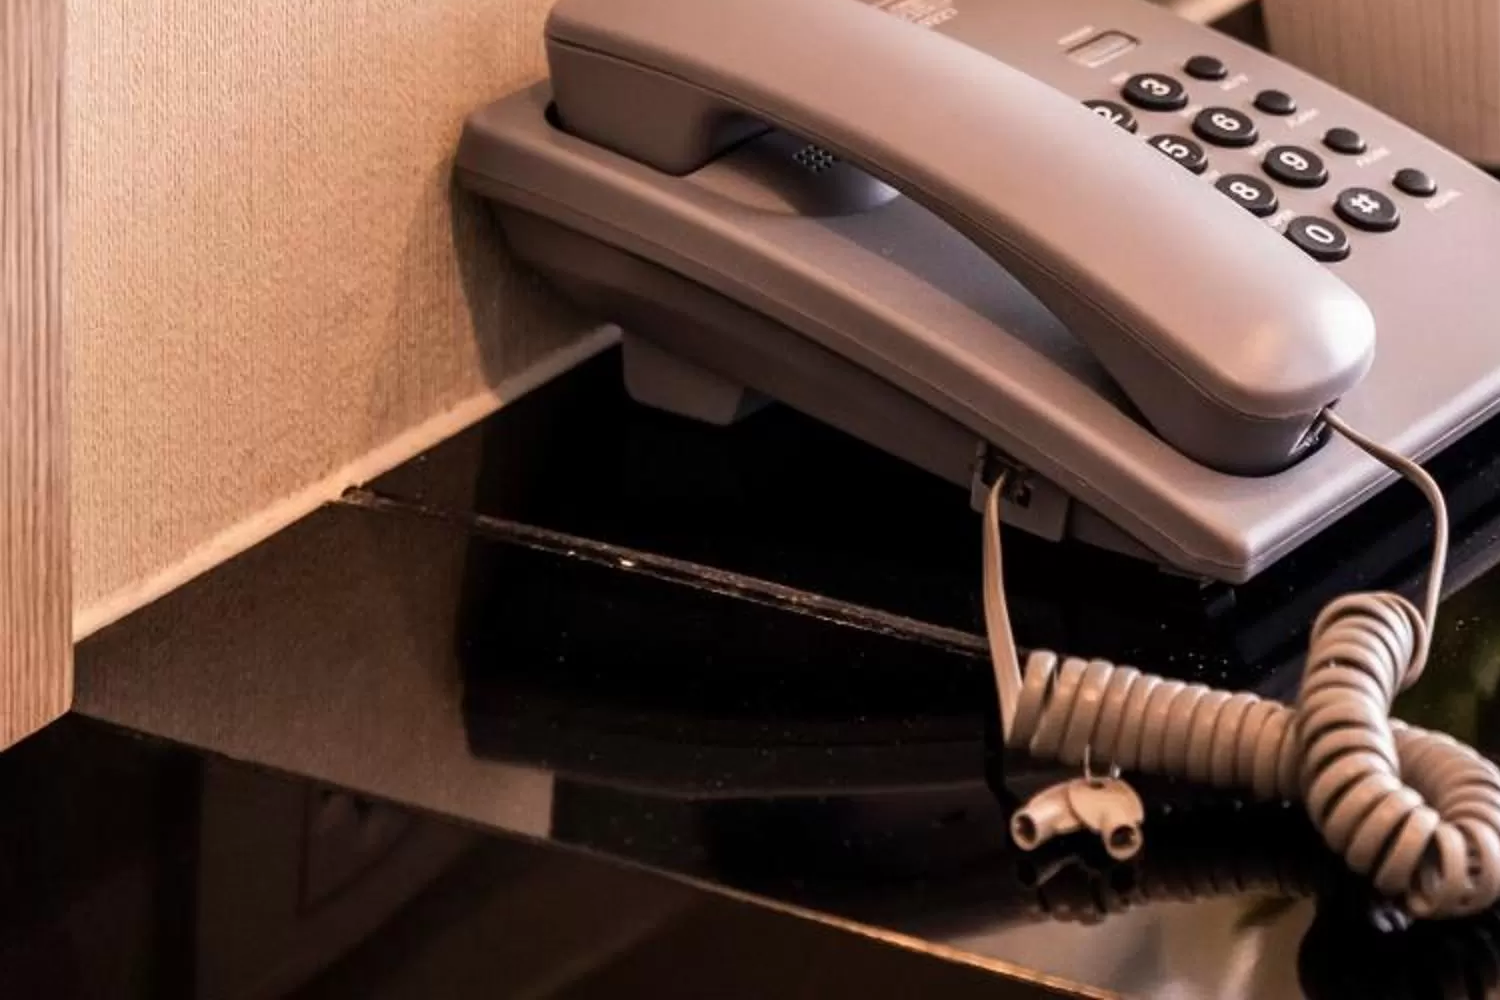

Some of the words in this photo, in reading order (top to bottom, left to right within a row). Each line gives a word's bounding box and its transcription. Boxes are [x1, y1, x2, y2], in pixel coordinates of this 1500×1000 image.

[1140, 78, 1171, 96] 3
[1211, 113, 1241, 131] 6
[1158, 138, 1190, 159] 5
[1279, 151, 1310, 171] 9
[1229, 181, 1261, 201] 8
[1350, 193, 1380, 213] #
[1305, 224, 1335, 244] 0
